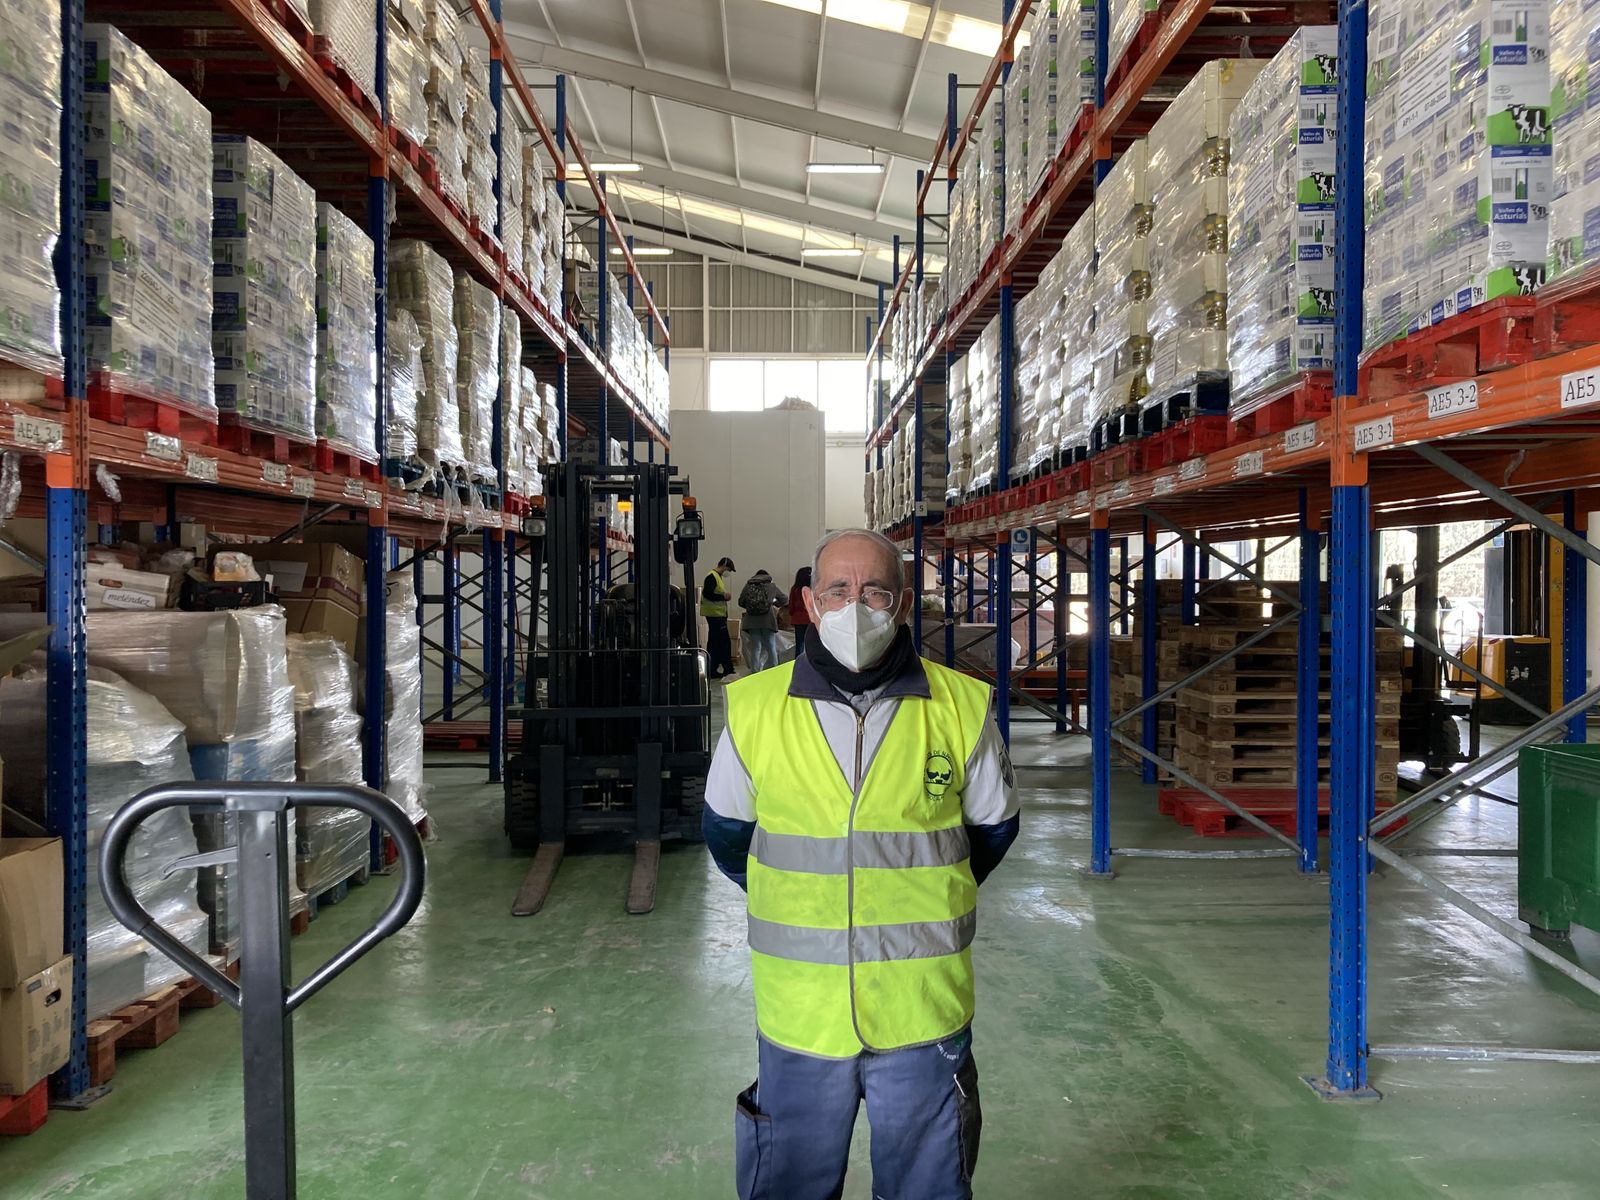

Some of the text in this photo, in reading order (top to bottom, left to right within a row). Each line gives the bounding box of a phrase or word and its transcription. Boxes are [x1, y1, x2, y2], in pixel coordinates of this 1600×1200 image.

[1430, 384, 1477, 413] AE5 3-2
[1564, 376, 1596, 402] AE5
[17, 422, 39, 439] AE4
[1303, 428, 1314, 444] 4-2
[1356, 422, 1393, 446] AE5 3-1
[107, 590, 151, 608] meléndez
